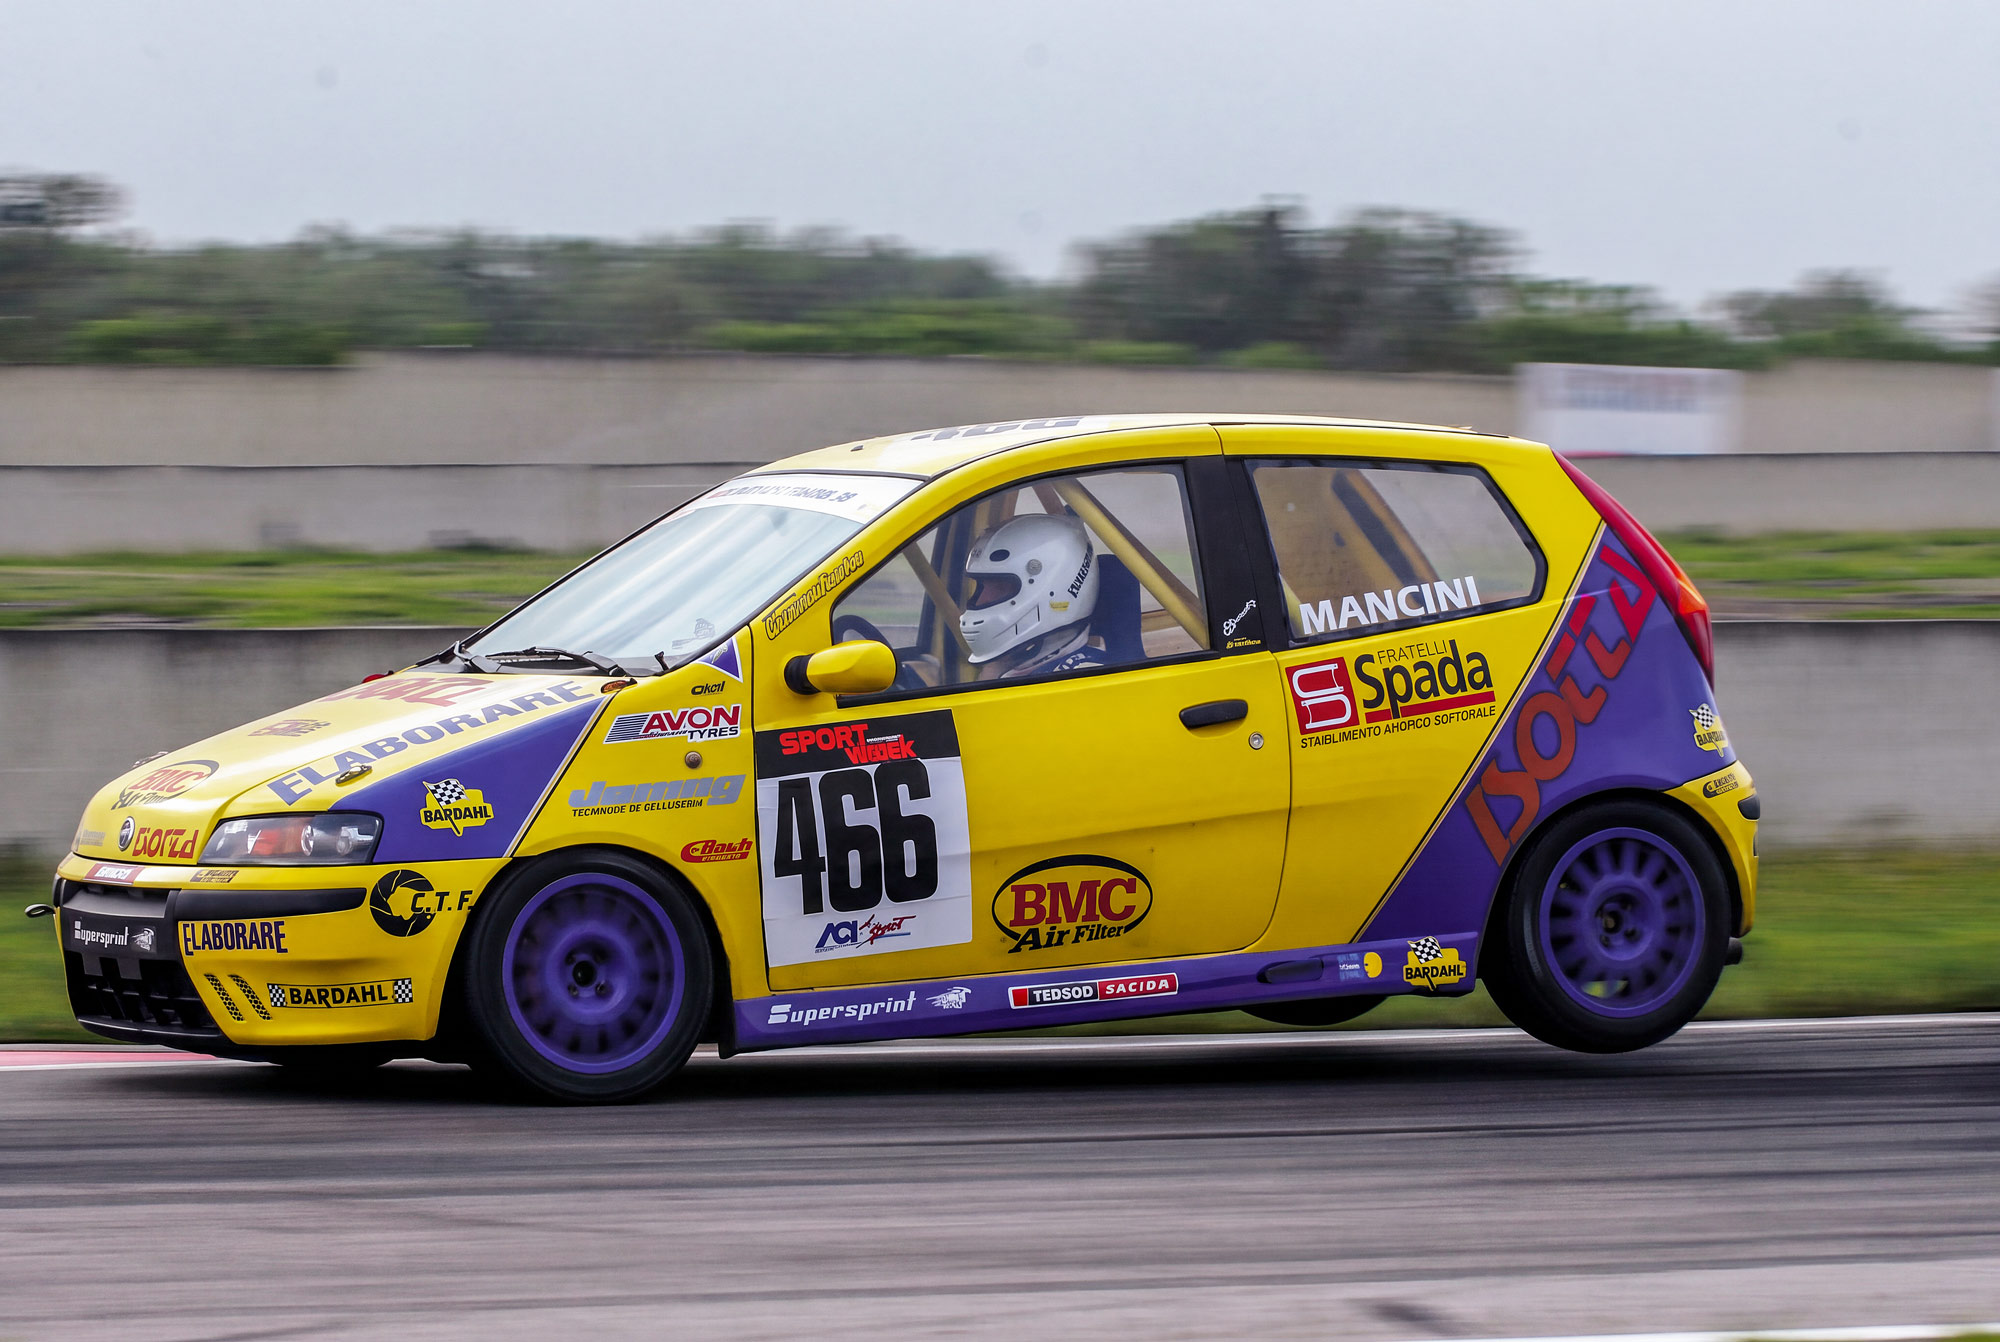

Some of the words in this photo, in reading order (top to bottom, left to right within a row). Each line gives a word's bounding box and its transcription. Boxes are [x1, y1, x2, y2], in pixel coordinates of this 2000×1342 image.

[1299, 575, 1481, 635] MANCINI
[1377, 639, 1449, 665] FRATELLI
[1354, 639, 1494, 719] Spada
[642, 705, 740, 734] AVON
[687, 726, 739, 740] TYRES
[267, 679, 596, 806] ELABORARE
[779, 723, 869, 756] SPORT
[423, 805, 492, 823] BARDAHL
[629, 803, 642, 813] DE
[774, 759, 938, 916] 466
[411, 889, 474, 914] C.T.F.
[1009, 878, 1137, 928] BMC
[182, 920, 289, 957] ELABORARE
[815, 920, 858, 949] ACI
[1007, 925, 1071, 954] Air
[1071, 923, 1125, 944] Filter
[1405, 965, 1464, 980] BARDAHL
[289, 984, 389, 1008] BARDAHL
[767, 990, 917, 1026] Supersprint
